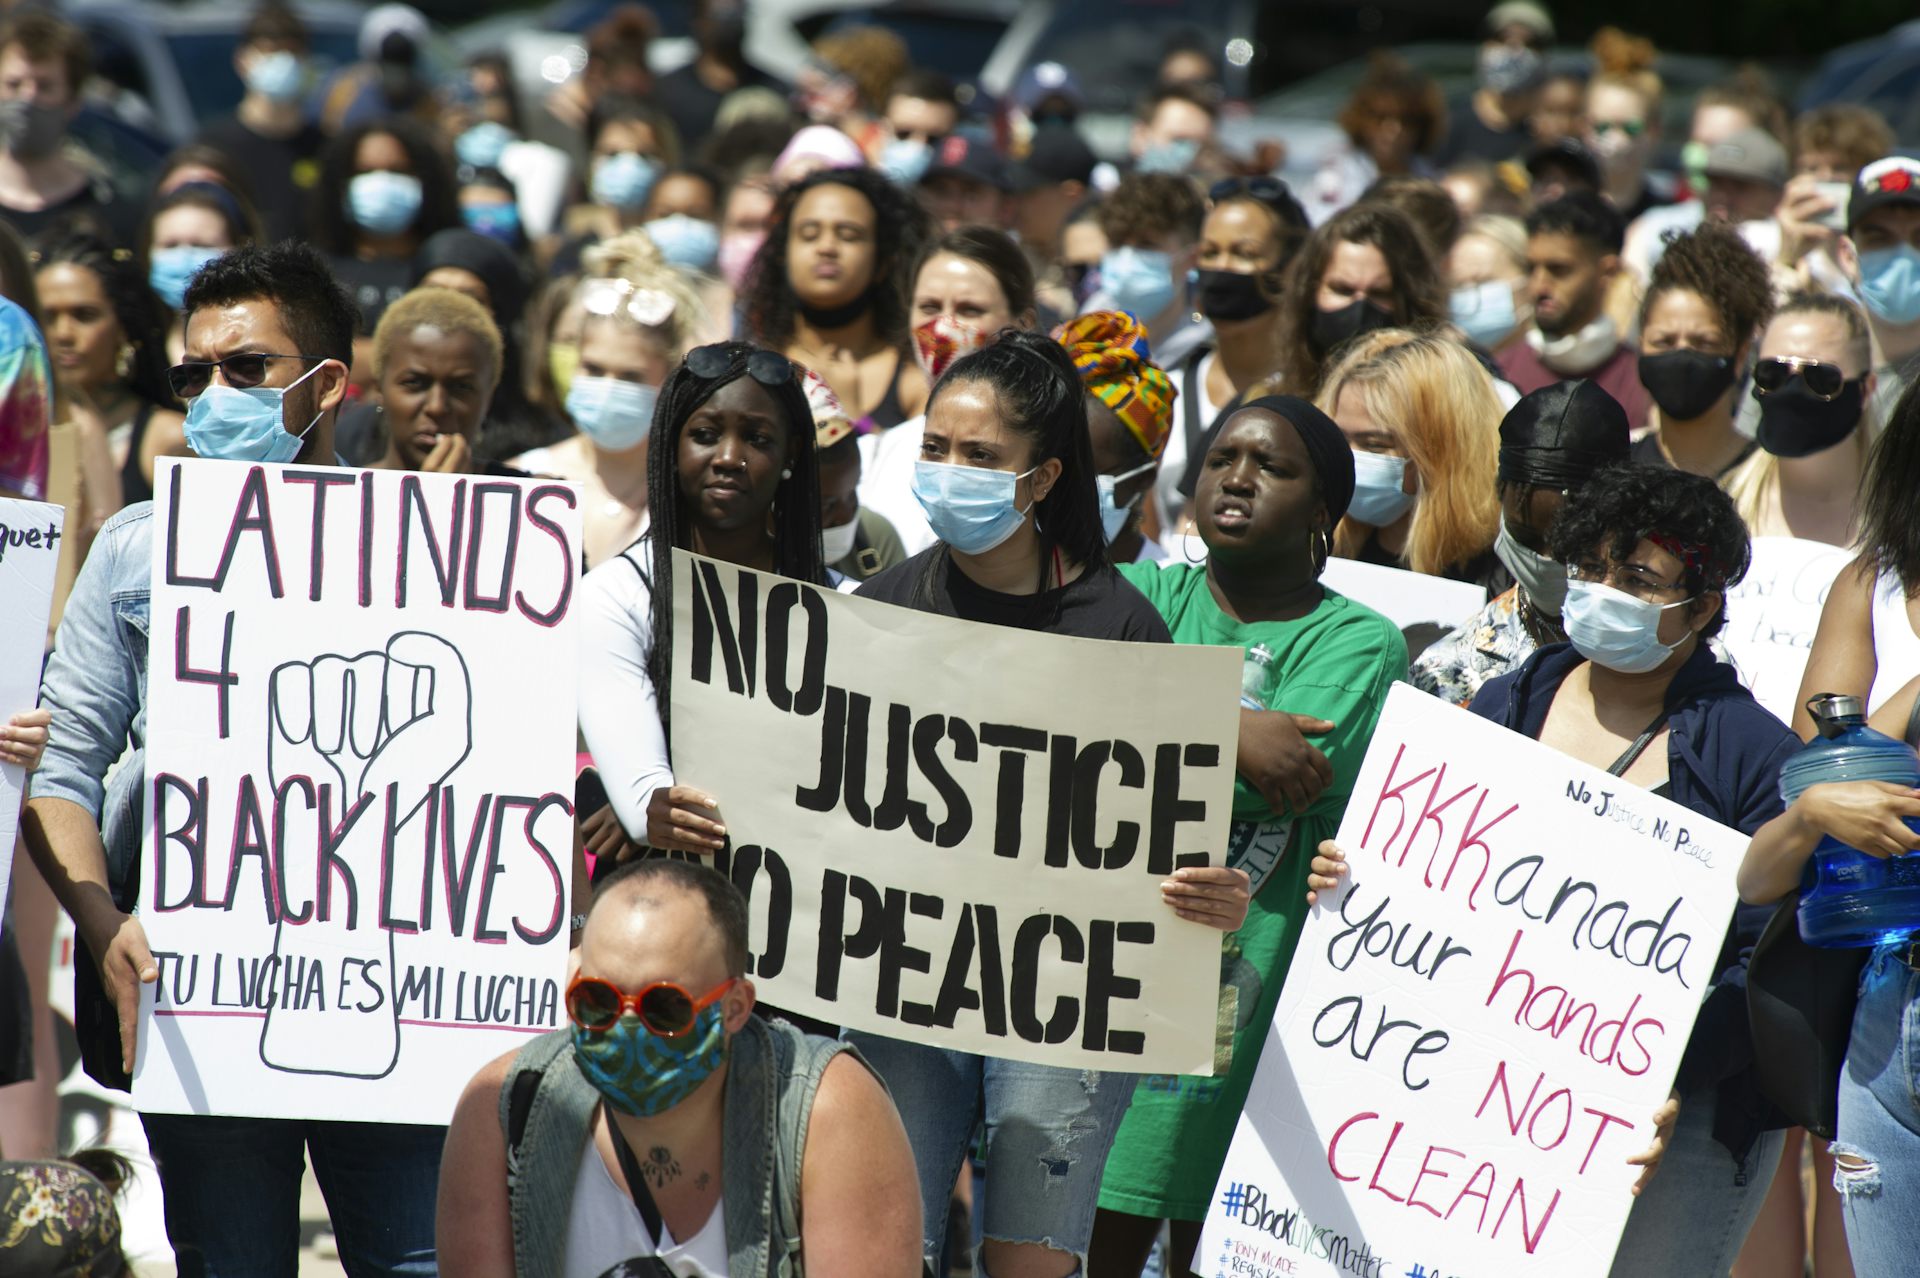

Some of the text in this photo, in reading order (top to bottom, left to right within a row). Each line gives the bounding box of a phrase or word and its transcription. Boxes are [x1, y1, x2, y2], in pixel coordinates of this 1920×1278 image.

[165, 464, 577, 627] LATINOS
[175, 605, 239, 738] 4
[689, 556, 828, 716] NO
[153, 772, 577, 946] BLACK LIVES
[794, 685, 1220, 877] JUSTICE
[1566, 779, 1716, 868] No Justice No Peace
[672, 833, 1156, 1056] O PEACE
[1360, 743, 1691, 989] KKKanada
[150, 950, 559, 1027] TU LUCHA ES MI LUCHA
[1327, 883, 1665, 1076] your hands
[1312, 995, 1635, 1175] are NOT
[1327, 1111, 1562, 1255] CLEAN
